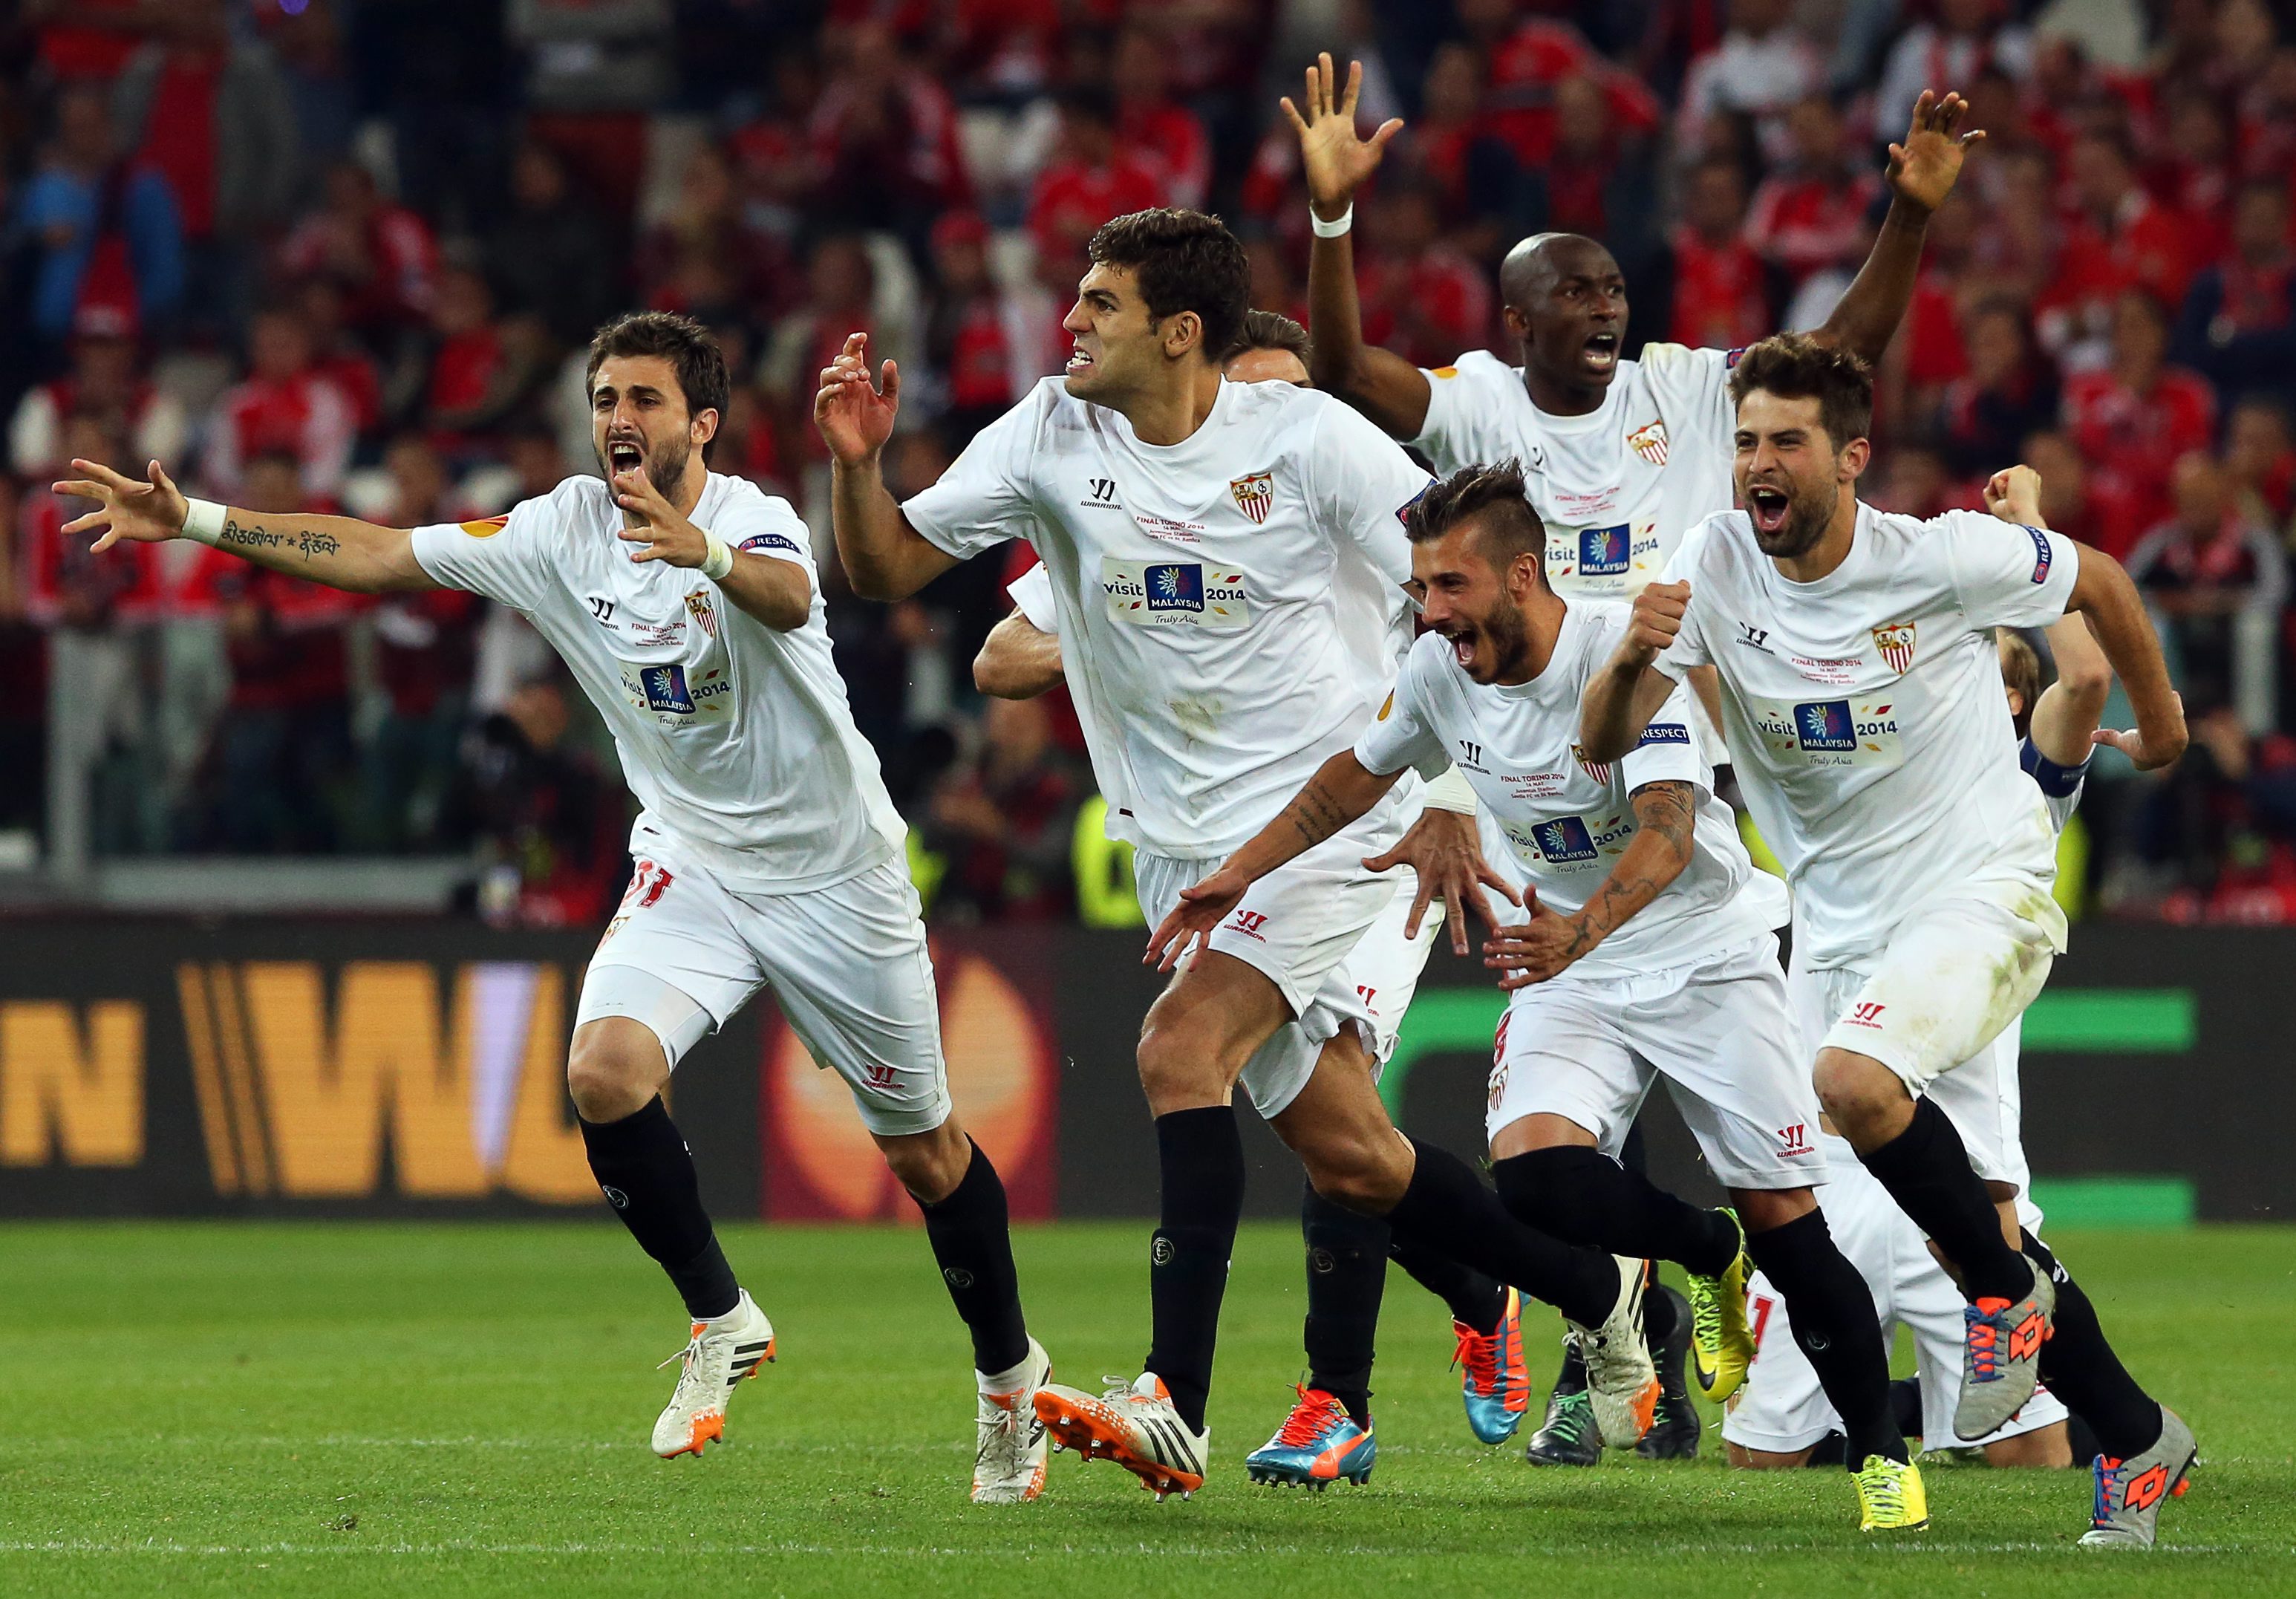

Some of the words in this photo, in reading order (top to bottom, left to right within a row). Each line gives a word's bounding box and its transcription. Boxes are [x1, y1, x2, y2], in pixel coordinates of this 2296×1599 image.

[1080, 501, 1122, 510] WARRIOR
[1136, 515, 1158, 525] FINAL
[757, 537, 798, 553] RESPEC
[1632, 538, 1658, 556] 2014
[1582, 561, 1628, 573] MALAYSIA
[1103, 581, 1144, 596] visit
[1206, 587, 1246, 601] 2014
[1151, 599, 1202, 610] MALAYSIA
[1155, 614, 1178, 625] Truly
[1179, 615, 1199, 625] Asia
[631, 622, 651, 632] FINAL
[1791, 658, 1815, 667] FINAL
[620, 676, 645, 697] visit
[691, 680, 731, 700] 2014
[652, 700, 694, 711] MALAYSIA
[1758, 719, 1795, 736] visit
[1857, 720, 1898, 736] 2014
[1640, 729, 1687, 739] RESPECT
[1803, 738, 1855, 748] MALAYSIA
[1808, 755, 1830, 766] Truly
[1831, 755, 1853, 765] Asia
[1522, 774, 1550, 782] TORINO
[1593, 824, 1632, 846] 2014
[1547, 850, 1597, 861] MALAYSIA
[1224, 924, 1266, 943] WARRIOR
